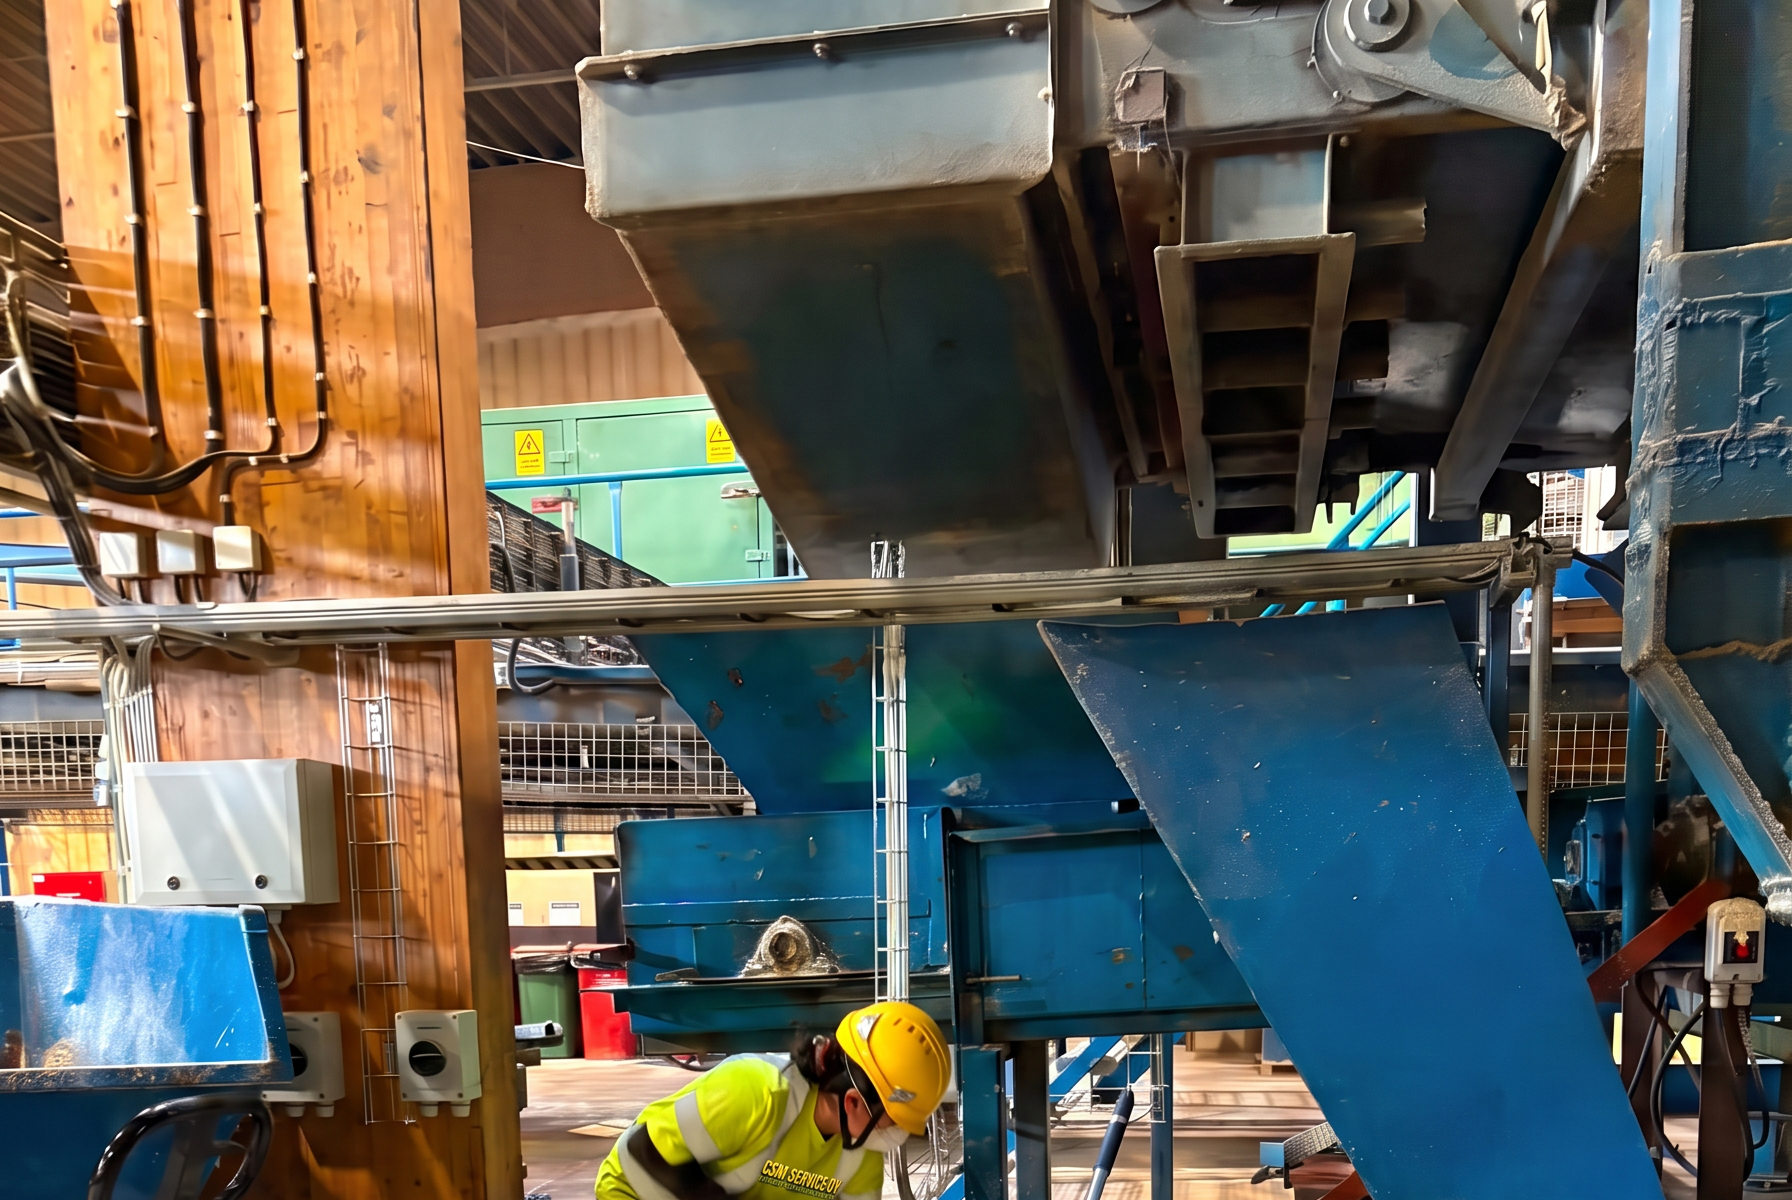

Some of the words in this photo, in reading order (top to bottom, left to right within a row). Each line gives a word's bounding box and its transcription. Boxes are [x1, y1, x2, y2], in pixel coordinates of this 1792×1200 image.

[762, 1160, 789, 1180] CSM
[787, 1168, 829, 1191] SERVICE
[826, 1178, 842, 1194] OY
